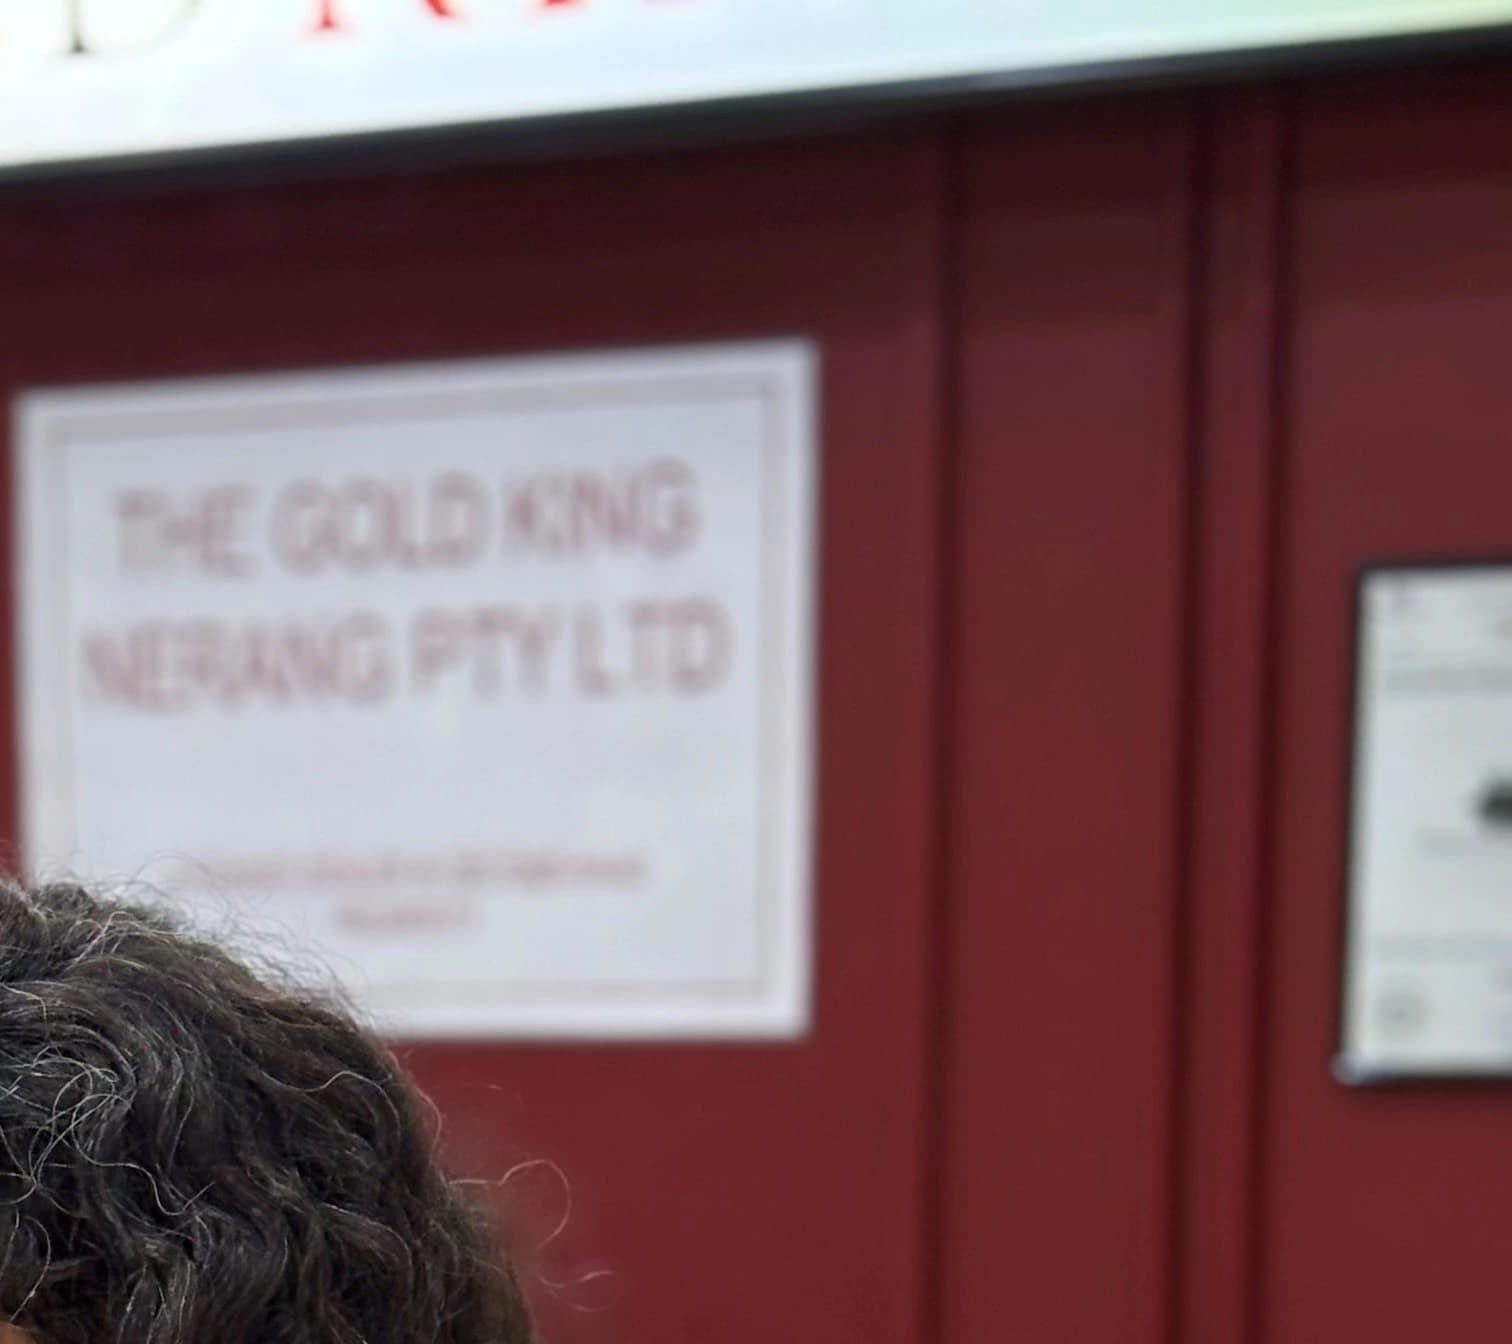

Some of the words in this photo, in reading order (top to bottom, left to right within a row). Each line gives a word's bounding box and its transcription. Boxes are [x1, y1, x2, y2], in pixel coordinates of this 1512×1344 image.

[114, 484, 254, 578] THE
[274, 470, 491, 573] GOLD
[503, 458, 702, 560] KING
[84, 612, 395, 713] NERANG
[410, 604, 568, 696] PTY
[574, 597, 734, 696] LTD
